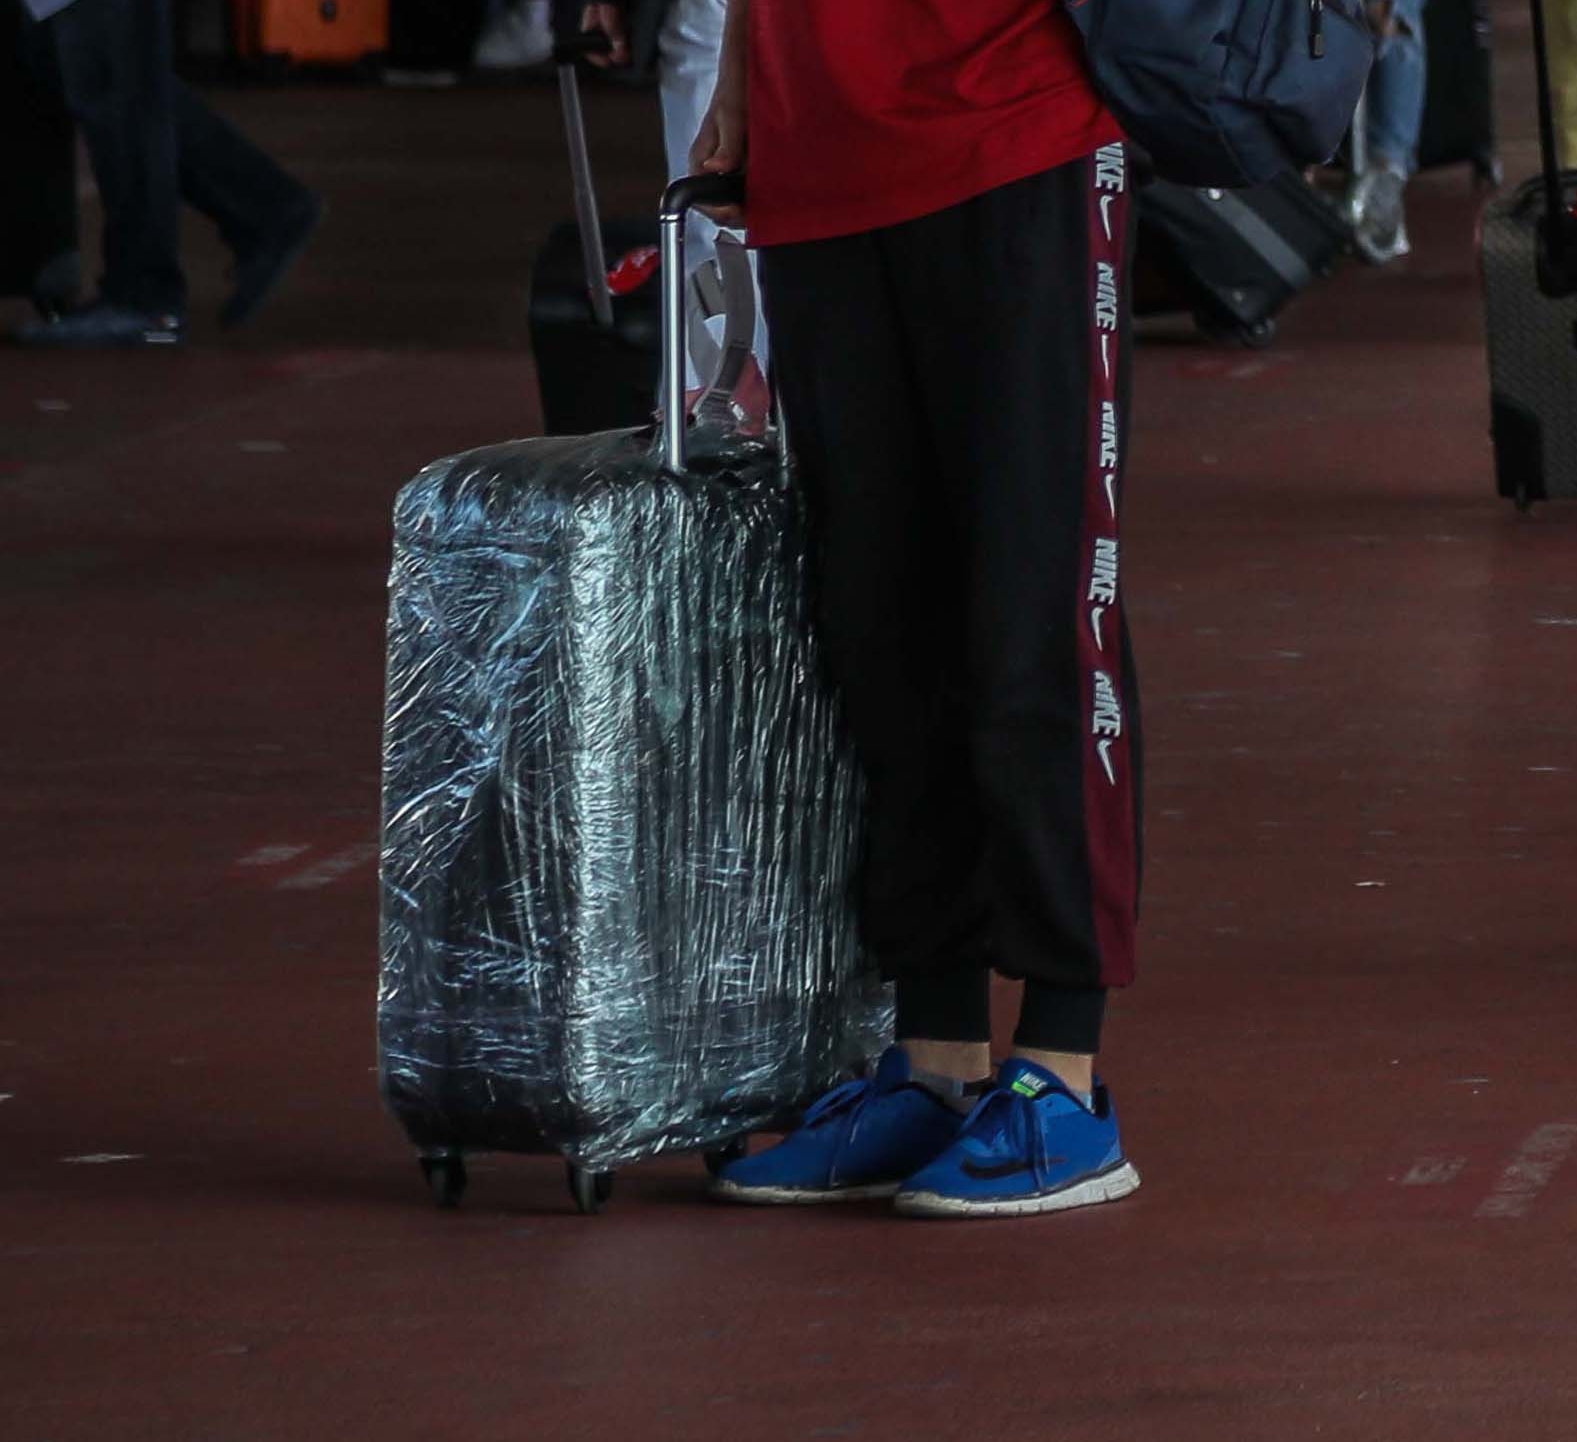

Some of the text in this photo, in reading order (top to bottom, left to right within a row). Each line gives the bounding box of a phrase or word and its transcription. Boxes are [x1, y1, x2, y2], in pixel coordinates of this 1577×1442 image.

[1096, 262, 1117, 332] NIKE
[1099, 401, 1118, 469] NIKE
[1087, 538, 1118, 606] NIKE
[1093, 670, 1121, 738] NIKE
